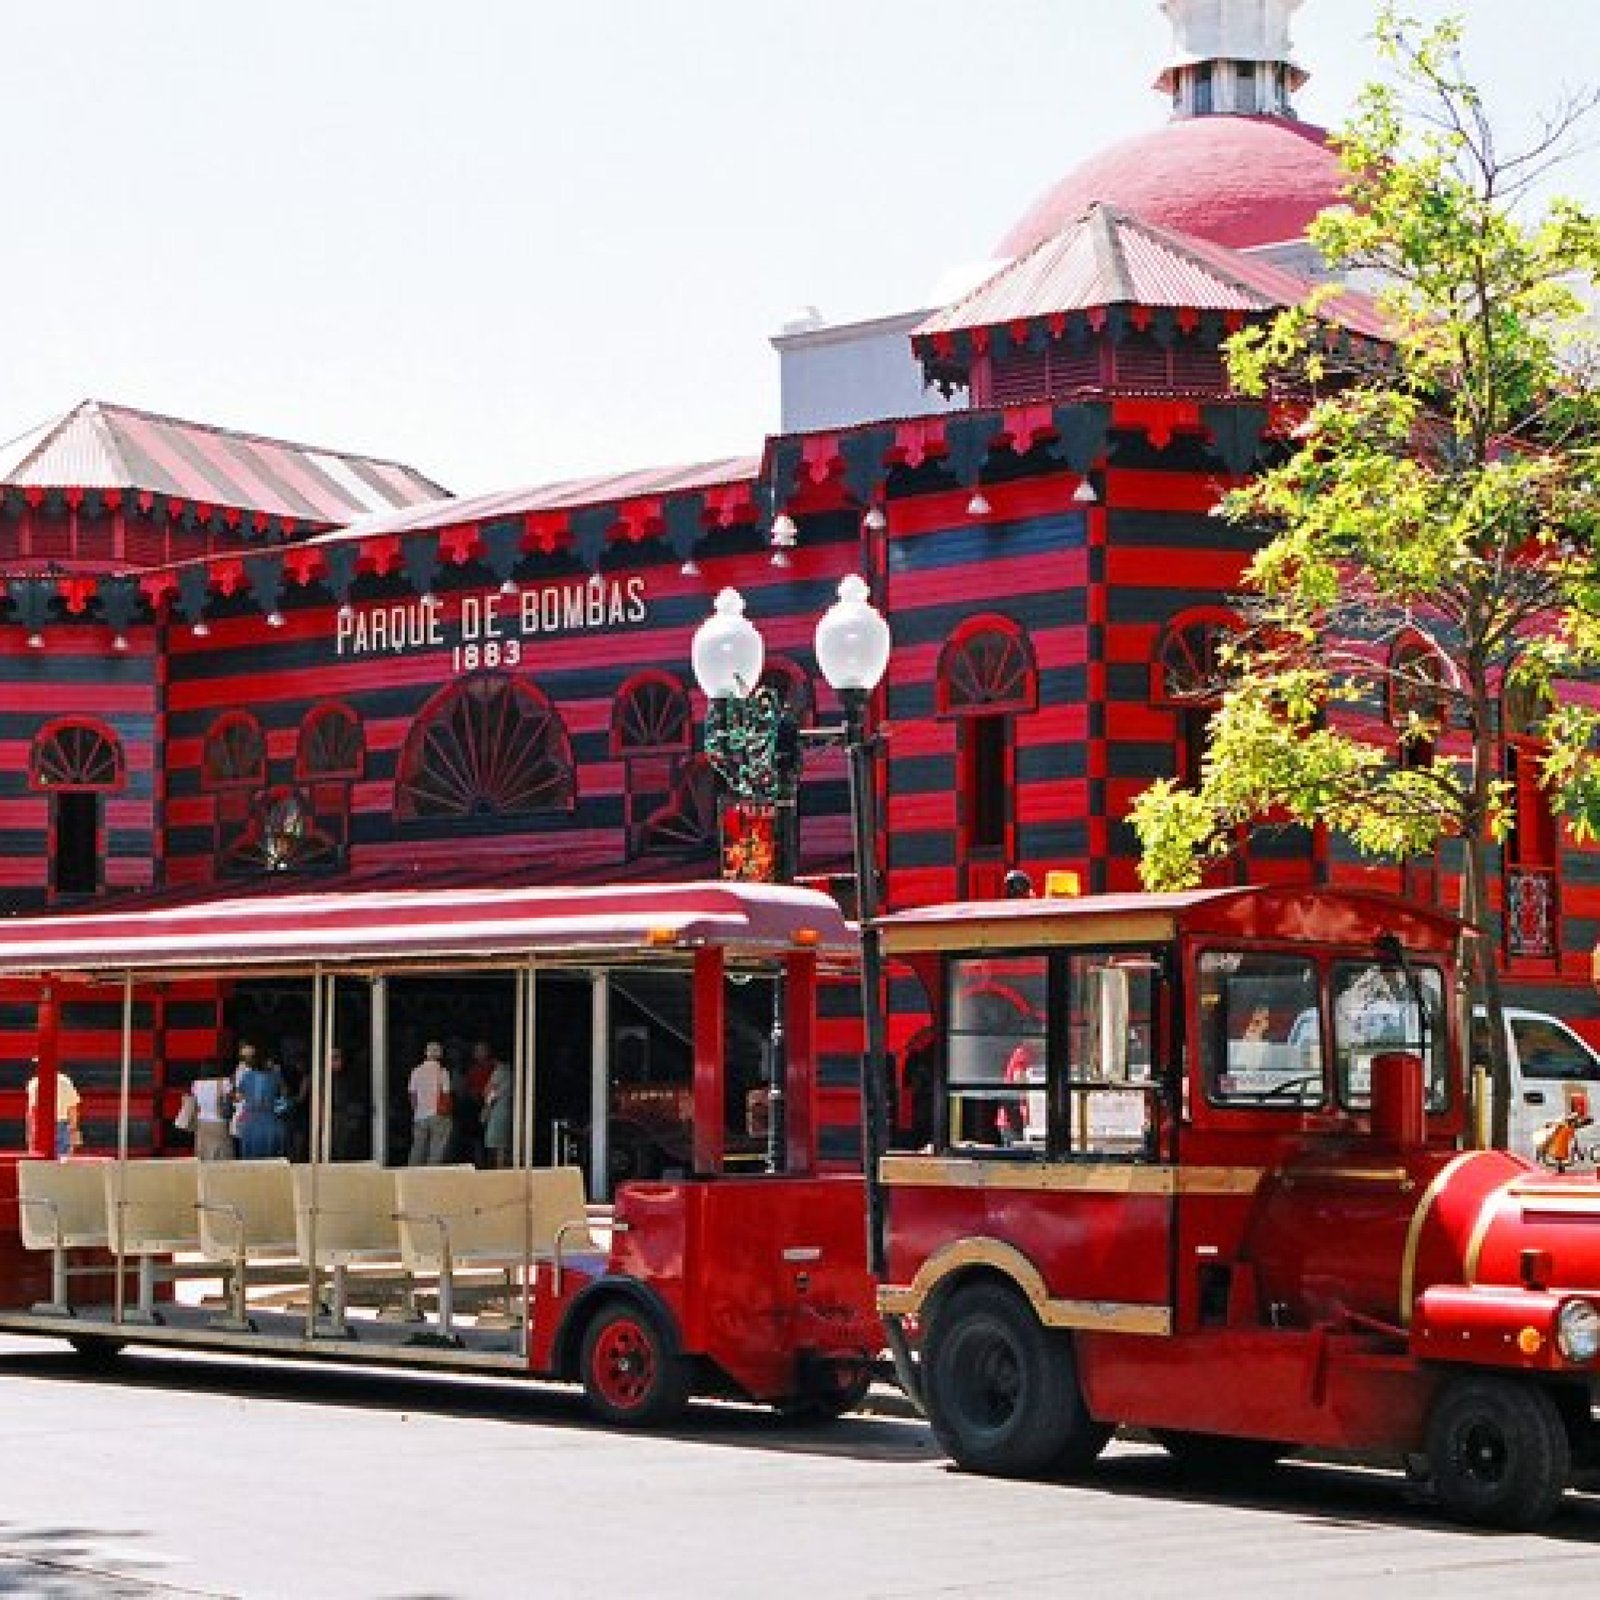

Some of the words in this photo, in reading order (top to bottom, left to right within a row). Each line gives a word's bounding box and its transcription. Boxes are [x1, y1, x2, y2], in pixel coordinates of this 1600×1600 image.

[337, 602, 444, 654] PARQUE
[462, 595, 502, 639] DE
[522, 577, 645, 634] BOMBAS
[452, 640, 520, 672] 1883
